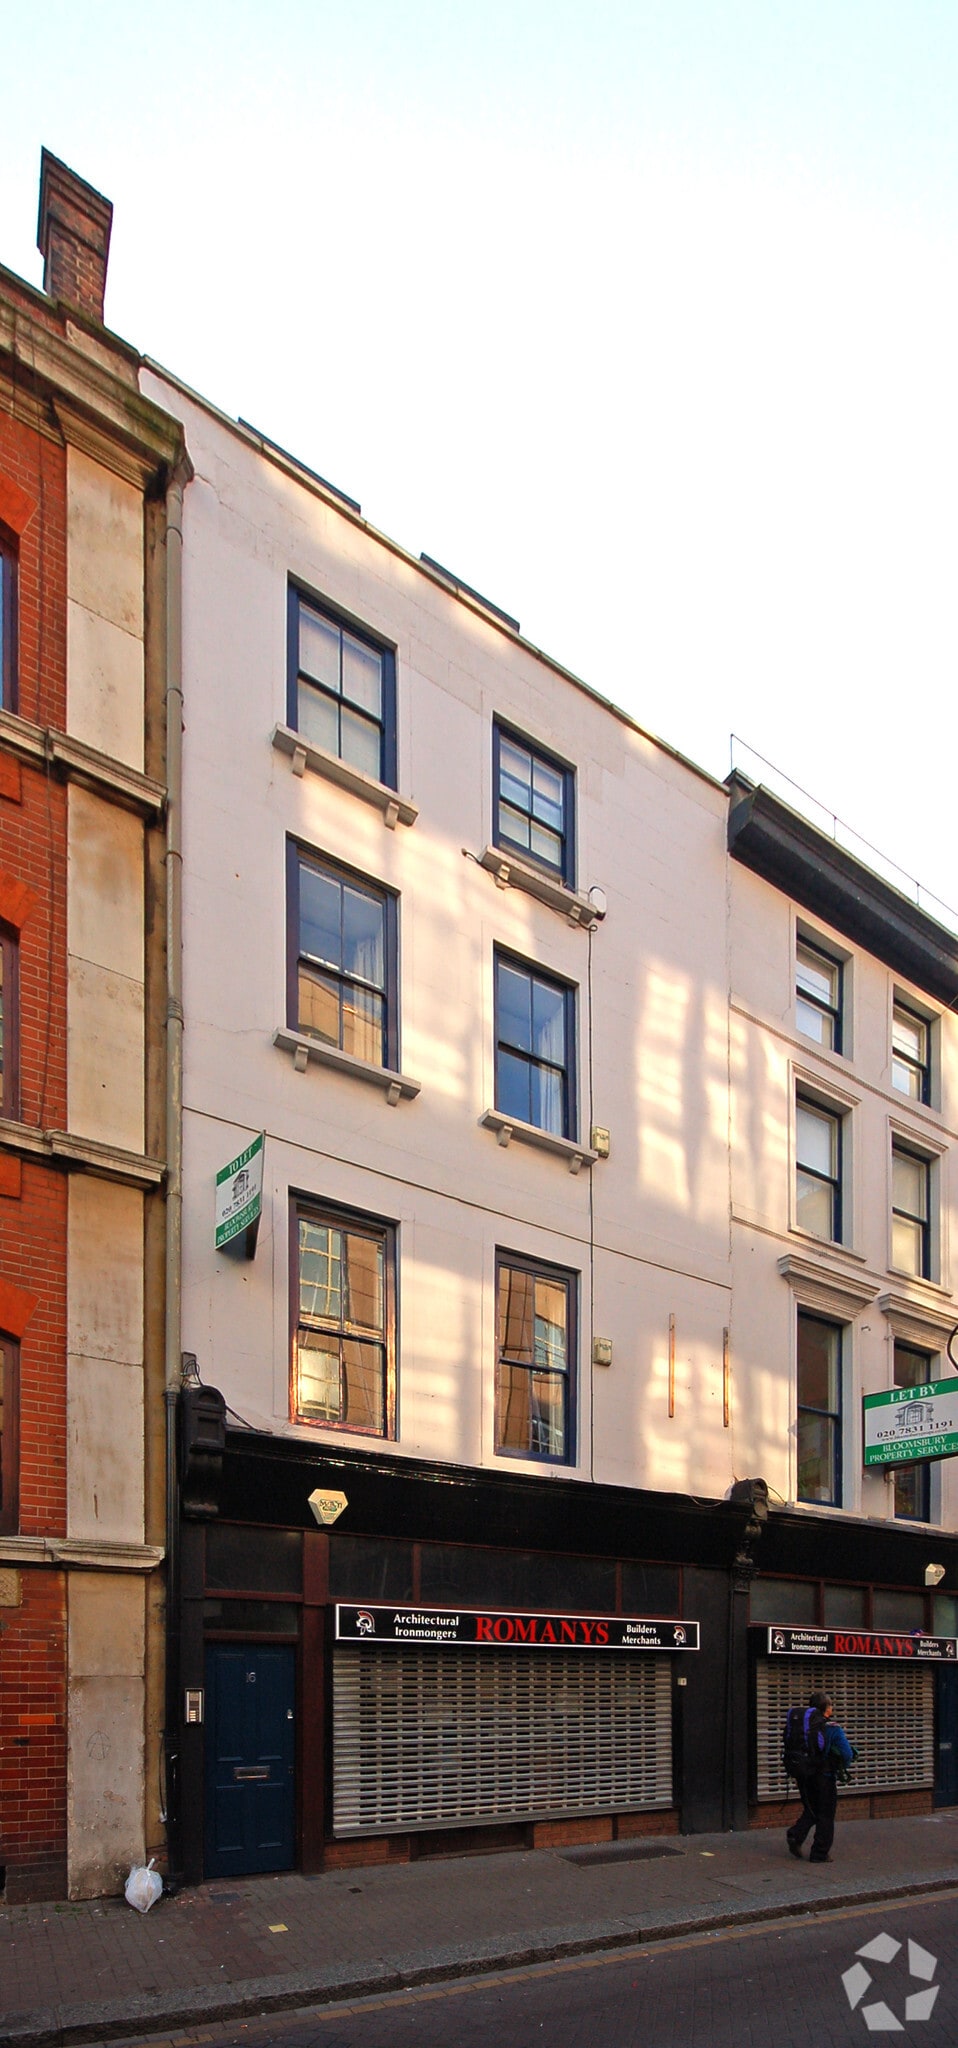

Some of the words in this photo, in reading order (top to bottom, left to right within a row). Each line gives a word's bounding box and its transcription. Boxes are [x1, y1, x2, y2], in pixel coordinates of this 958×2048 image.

[229, 1160, 239, 1175] TO
[240, 1146, 253, 1167] LET
[890, 1388, 916, 1402] LET
[920, 1384, 938, 1395] BY
[877, 1429, 895, 1438] 020
[899, 1425, 924, 1435] 7831
[929, 1420, 953, 1430] 1191
[882, 1435, 947, 1452] BLOOMSBURY
[869, 1449, 913, 1463] PROPERTY
[393, 1613, 460, 1627] Architectural
[395, 1626, 457, 1641] Ironmongers
[474, 1616, 609, 1645] ROMANYS
[626, 1624, 657, 1634] Builders
[621, 1635, 661, 1646] Merchants
[790, 1632, 829, 1643] Architectural
[919, 1640, 939, 1648] Builders
[791, 1642, 827, 1653] Ironmongers
[834, 1634, 914, 1657] ROMANYS
[917, 1648, 942, 1657] Merchants
[246, 1671, 256, 1683] 16
